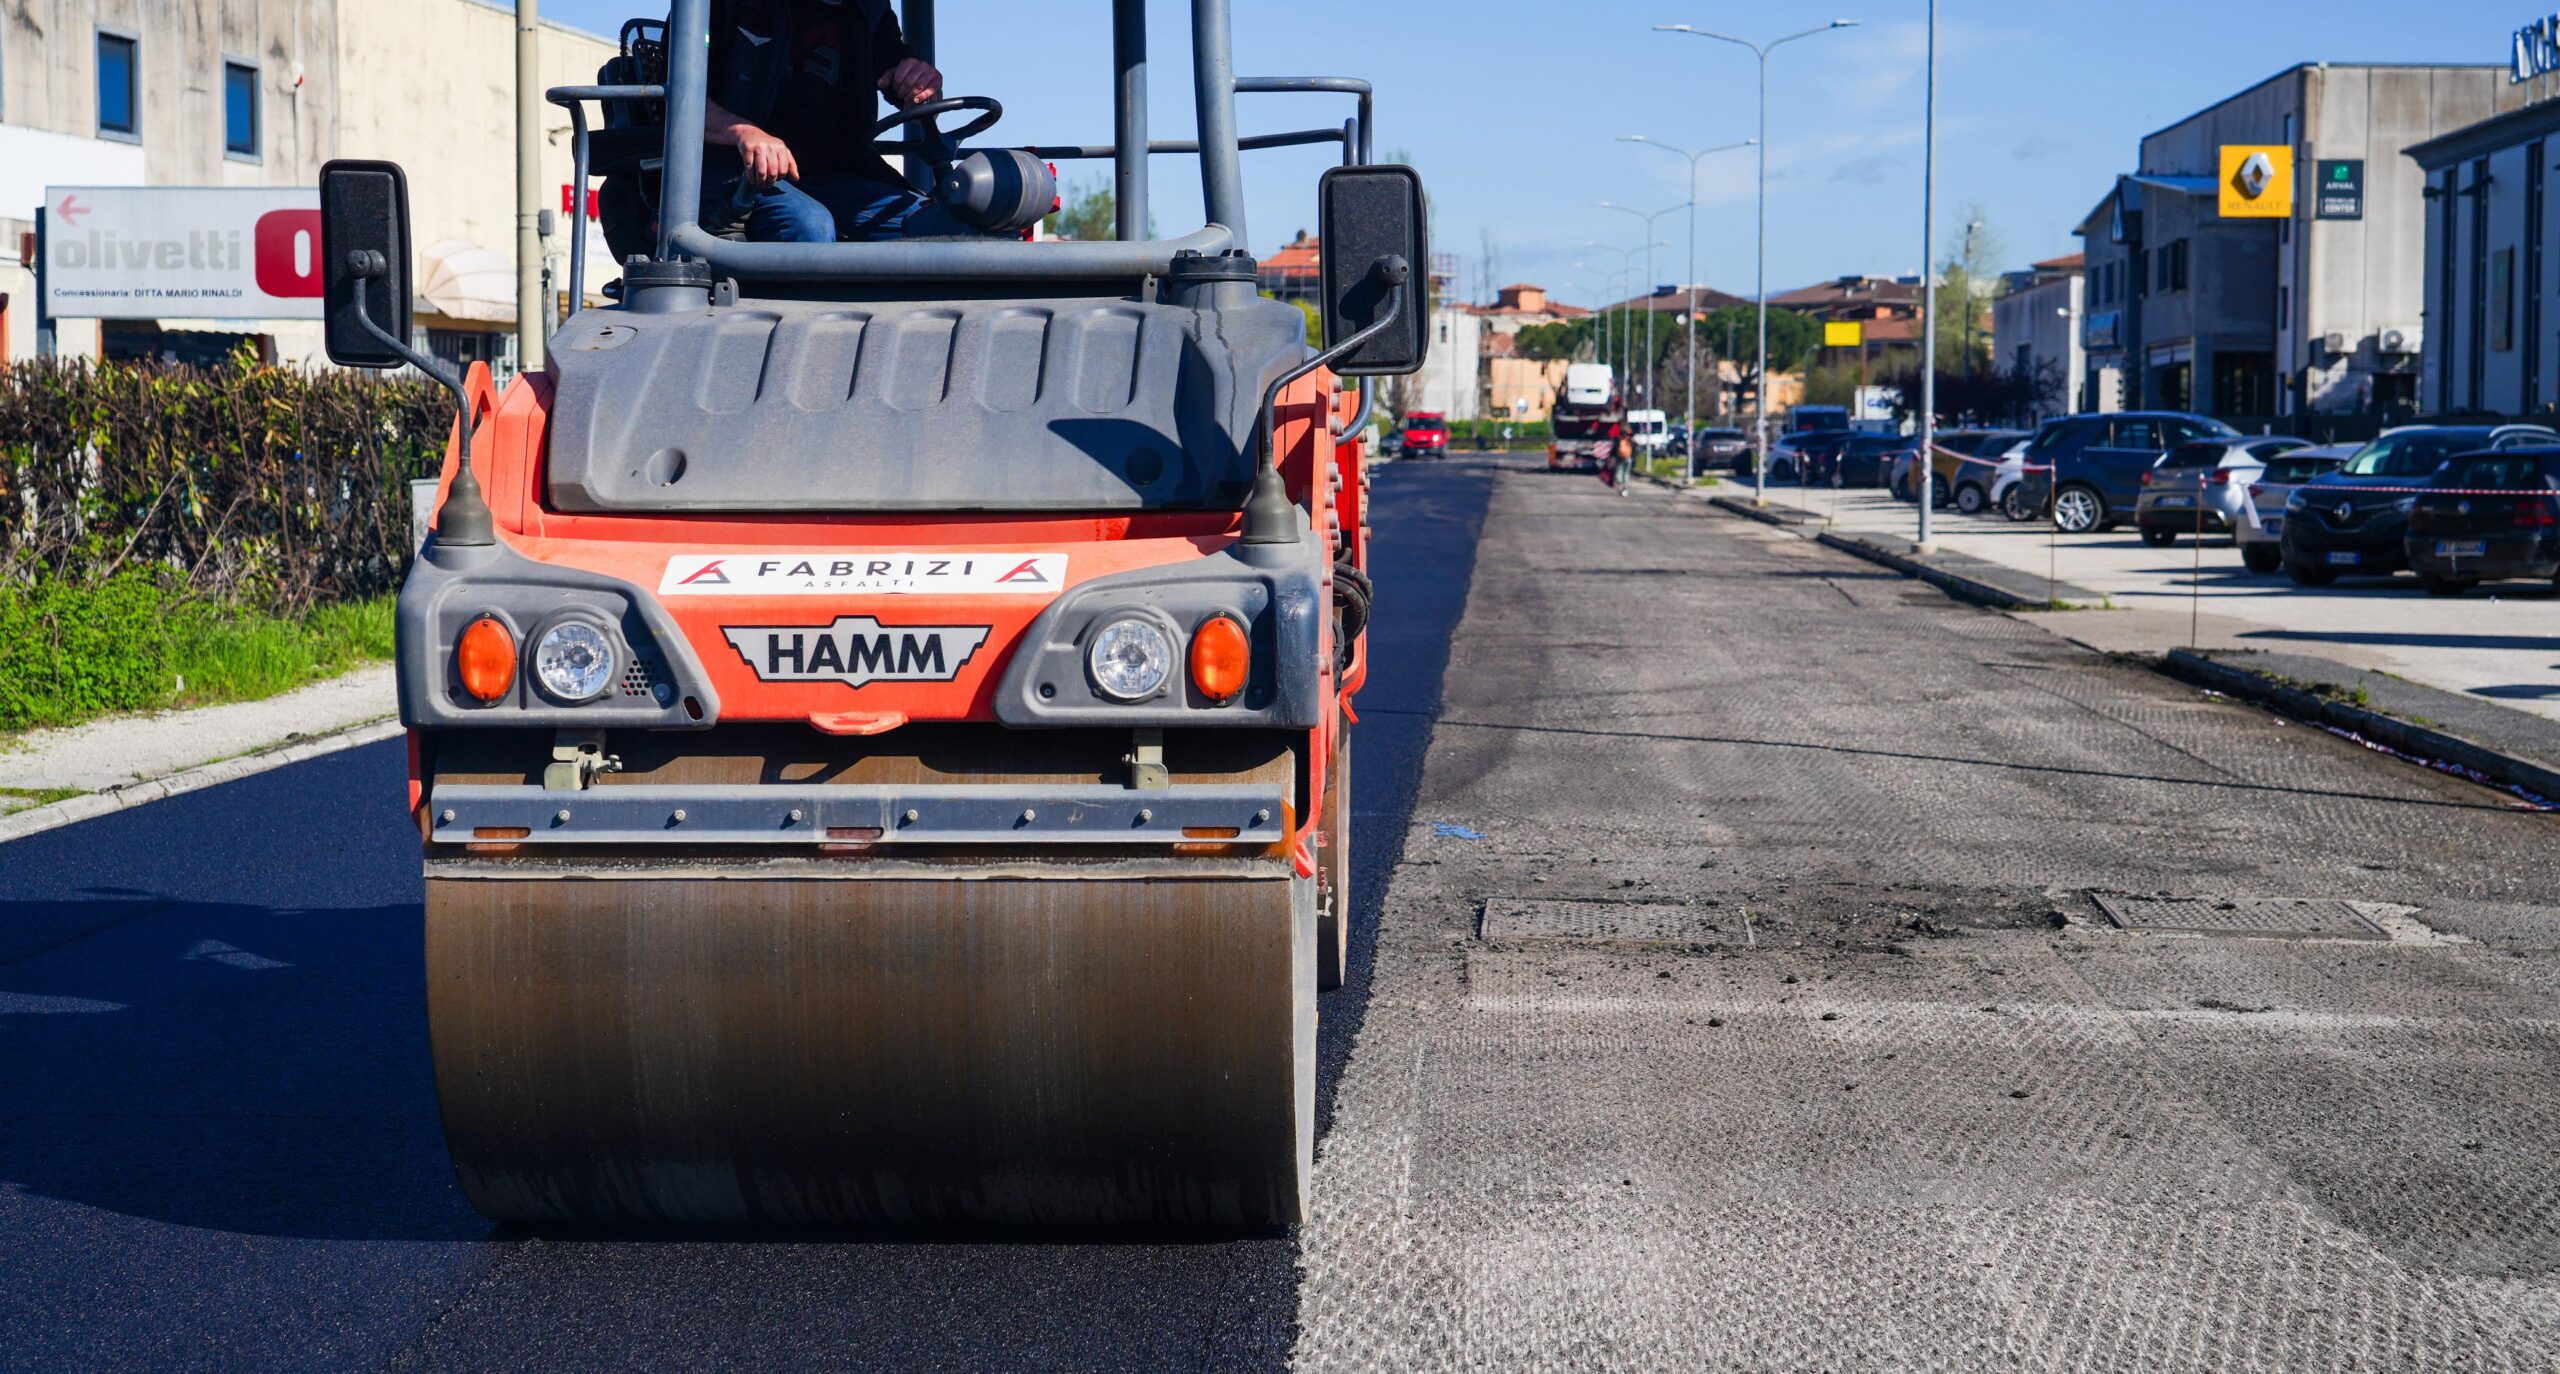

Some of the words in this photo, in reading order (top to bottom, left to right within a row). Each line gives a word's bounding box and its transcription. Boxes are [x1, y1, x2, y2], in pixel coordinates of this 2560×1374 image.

[2325, 181, 2355, 190] ARVAL
[2227, 201, 2281, 211] RENAULT
[2324, 204, 2356, 213] CENTER
[54, 230, 241, 271] olivetti
[135, 288, 163, 298] DITTA
[166, 288, 198, 298] MARIO
[201, 288, 243, 298] RINALDI
[757, 560, 974, 577] FABRIZI
[803, 578, 916, 588] ASFALTI
[767, 633, 947, 674] HAMM
